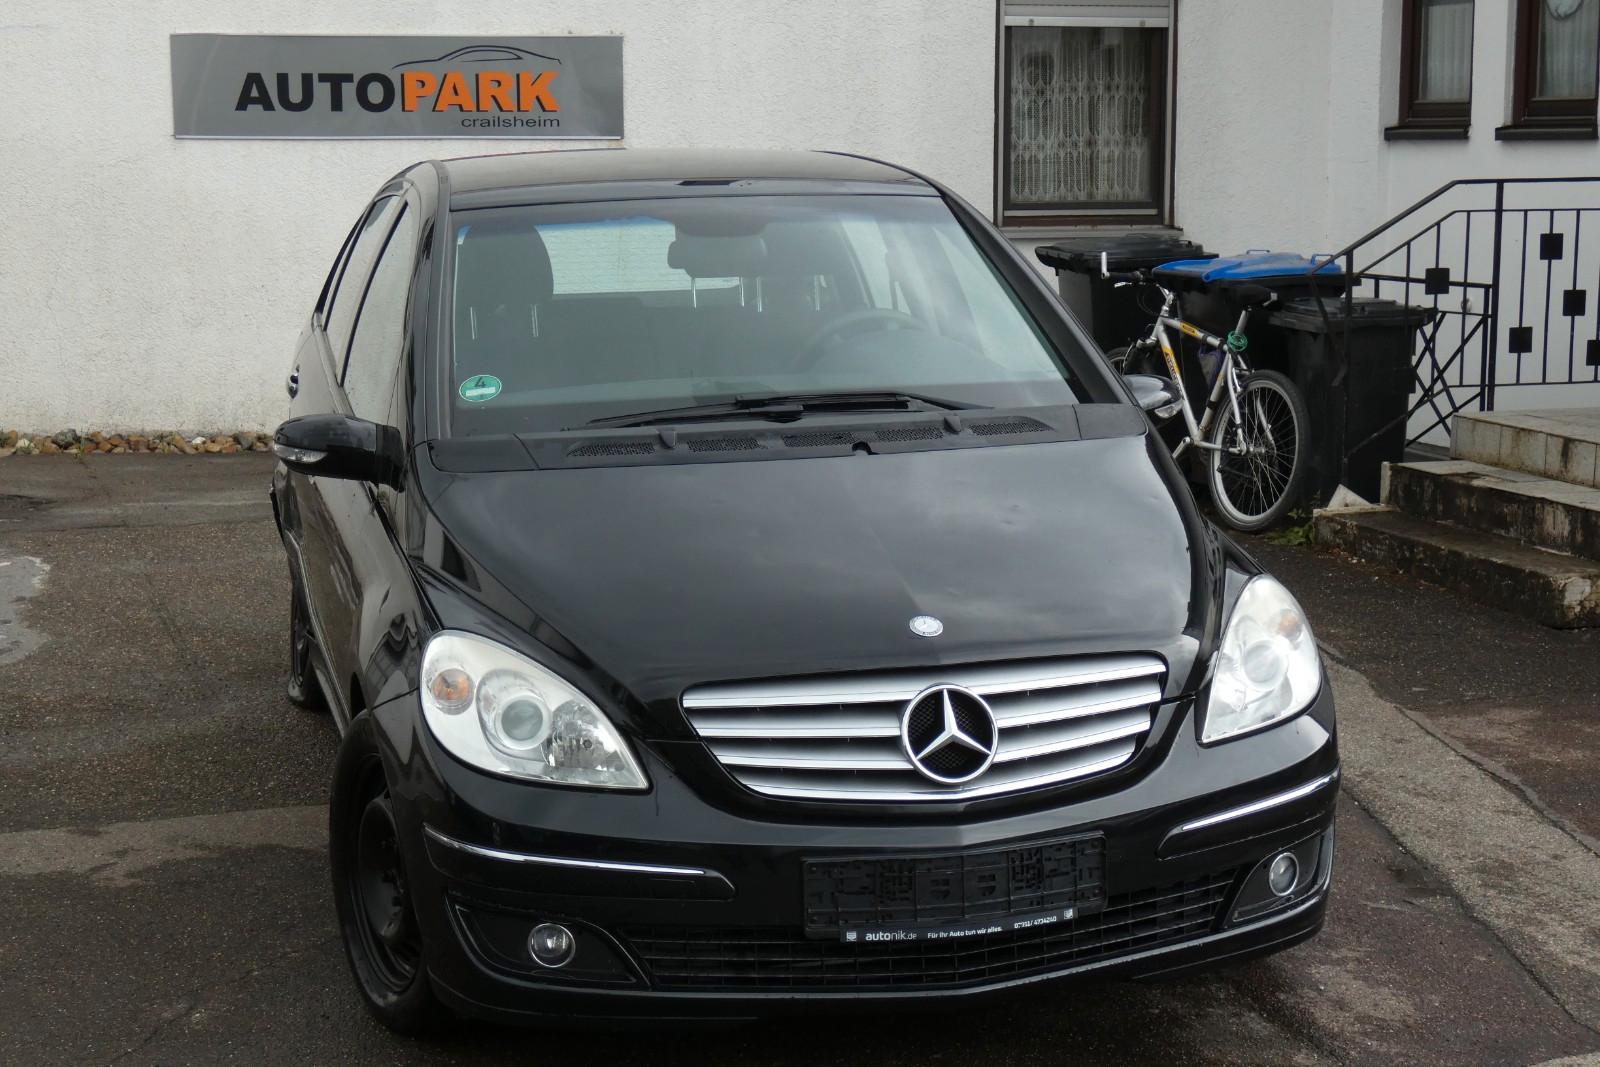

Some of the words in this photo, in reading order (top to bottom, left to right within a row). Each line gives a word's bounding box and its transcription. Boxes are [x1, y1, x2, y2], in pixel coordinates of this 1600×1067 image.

[235, 71, 560, 112] AUTOPARK
[461, 116, 560, 128] crailsheim
[474, 376, 486, 388] 4
[865, 930, 917, 941] autonik.de
